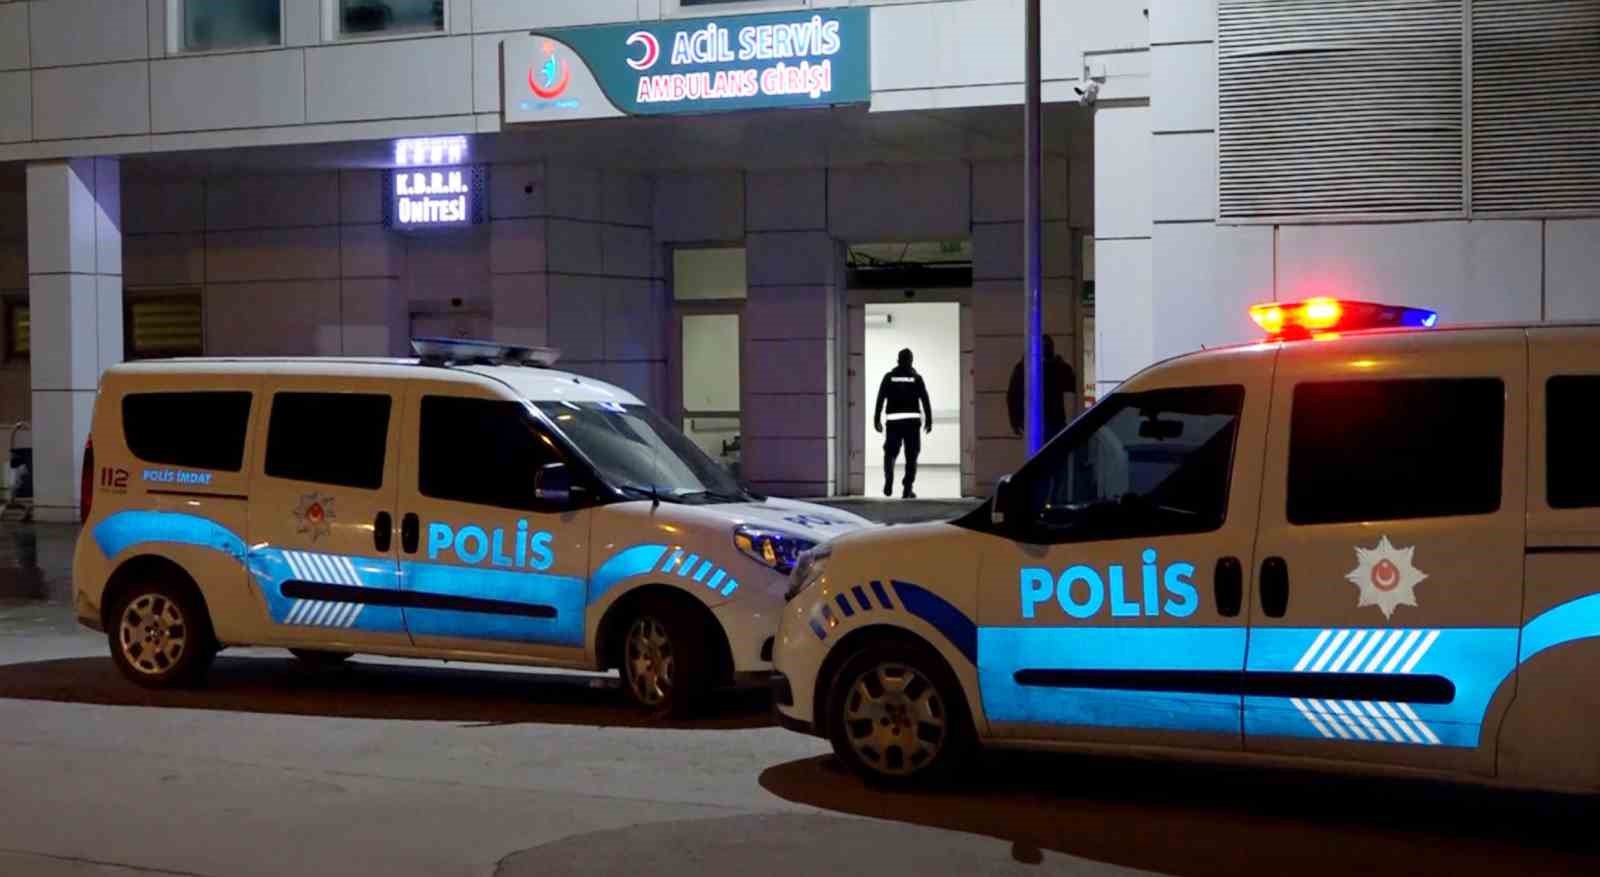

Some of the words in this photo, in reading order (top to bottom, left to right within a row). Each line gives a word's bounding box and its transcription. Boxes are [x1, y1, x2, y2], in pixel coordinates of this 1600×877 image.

[671, 22, 733, 65] ACİL
[738, 15, 841, 61] SERVİS
[636, 69, 758, 102] AMBULANS
[759, 60, 832, 98] GİRİŞİ
[101, 467, 128, 488] 112
[427, 518, 555, 570] POLİS
[1020, 548, 1199, 618] POLİS
